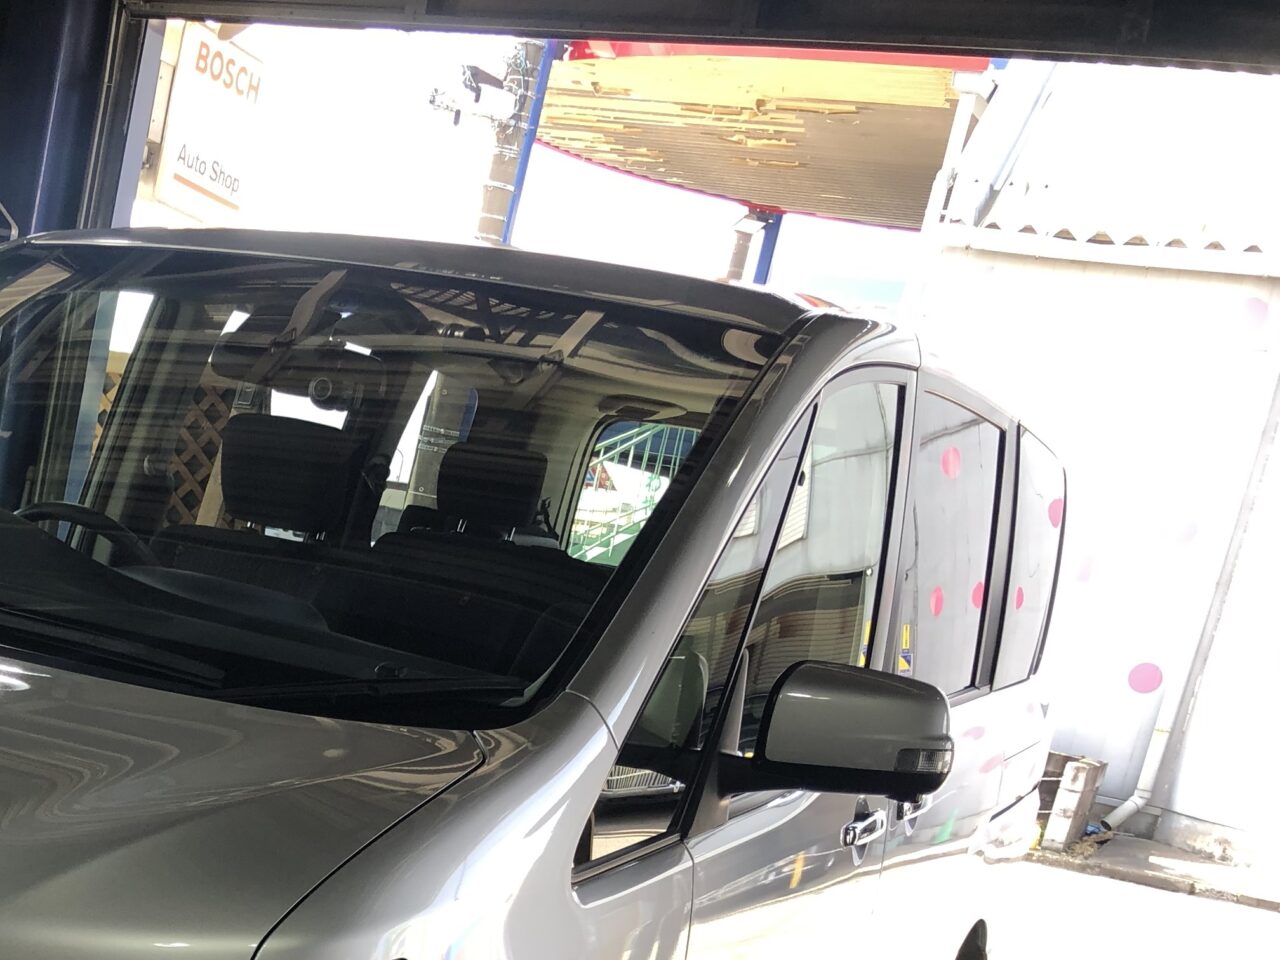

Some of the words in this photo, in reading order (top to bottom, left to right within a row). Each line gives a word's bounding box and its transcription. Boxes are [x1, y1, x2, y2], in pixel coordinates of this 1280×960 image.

[195, 40, 261, 104] BOSCH
[177, 143, 207, 176] Auto
[209, 160, 240, 196] Shop
